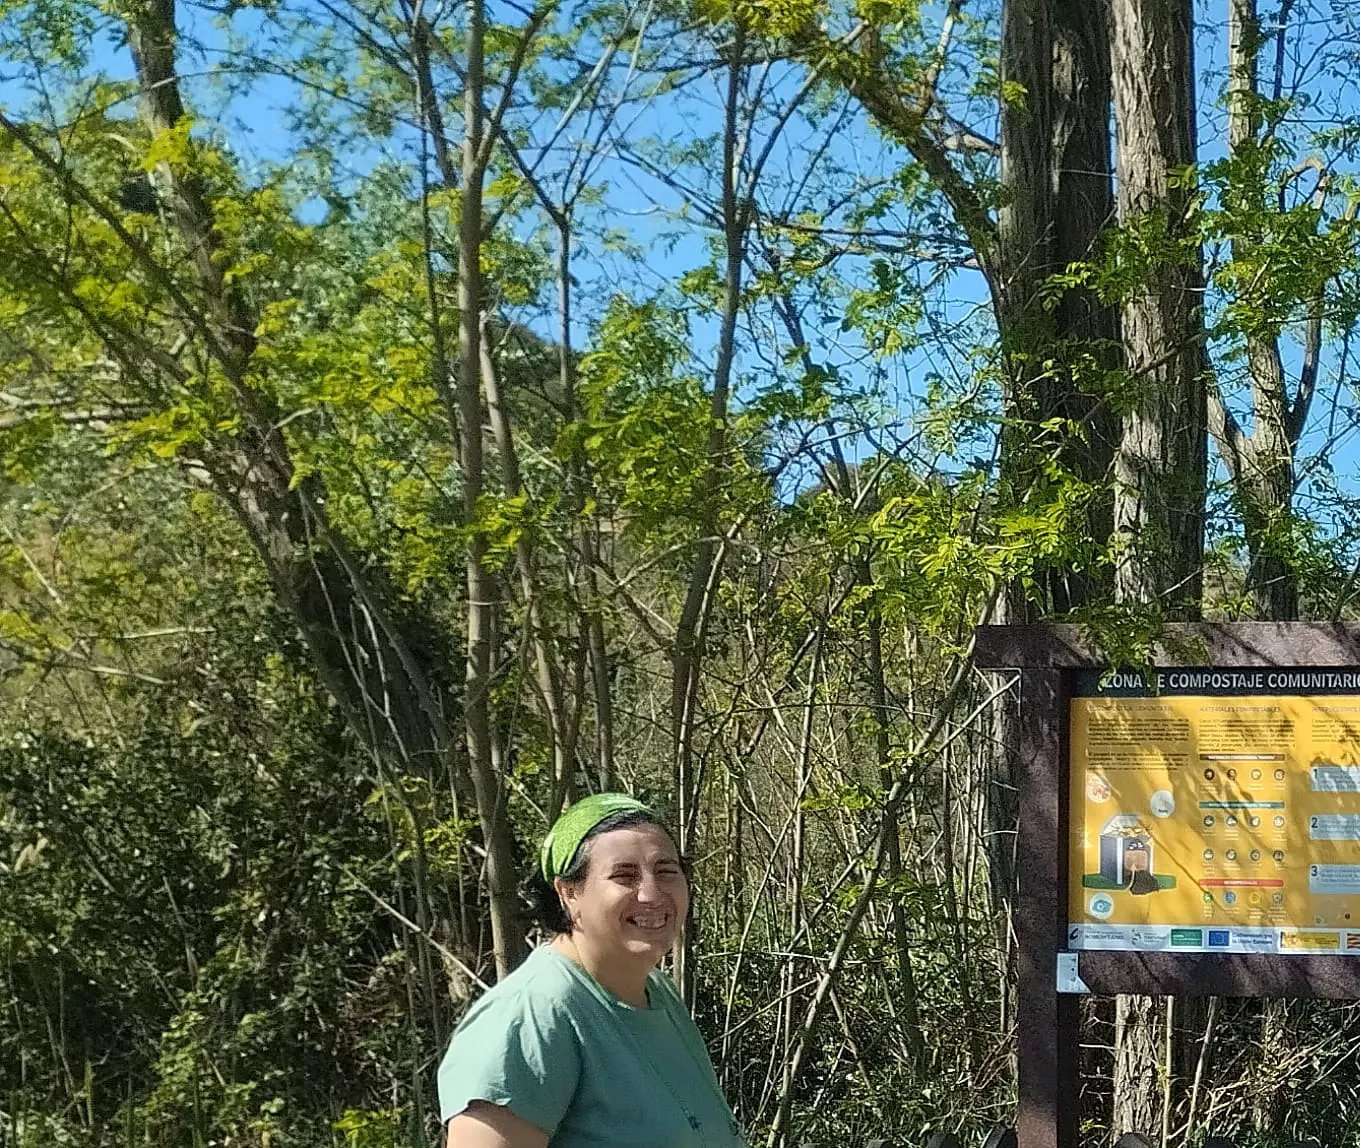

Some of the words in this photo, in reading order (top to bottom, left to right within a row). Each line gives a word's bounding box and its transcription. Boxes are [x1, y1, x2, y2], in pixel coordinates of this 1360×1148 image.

[1103, 673, 1143, 688] ZONA
[1169, 673, 1263, 689] COMPOSTAJE
[1311, 817, 1318, 828] 2
[1311, 865, 1318, 877] 3
